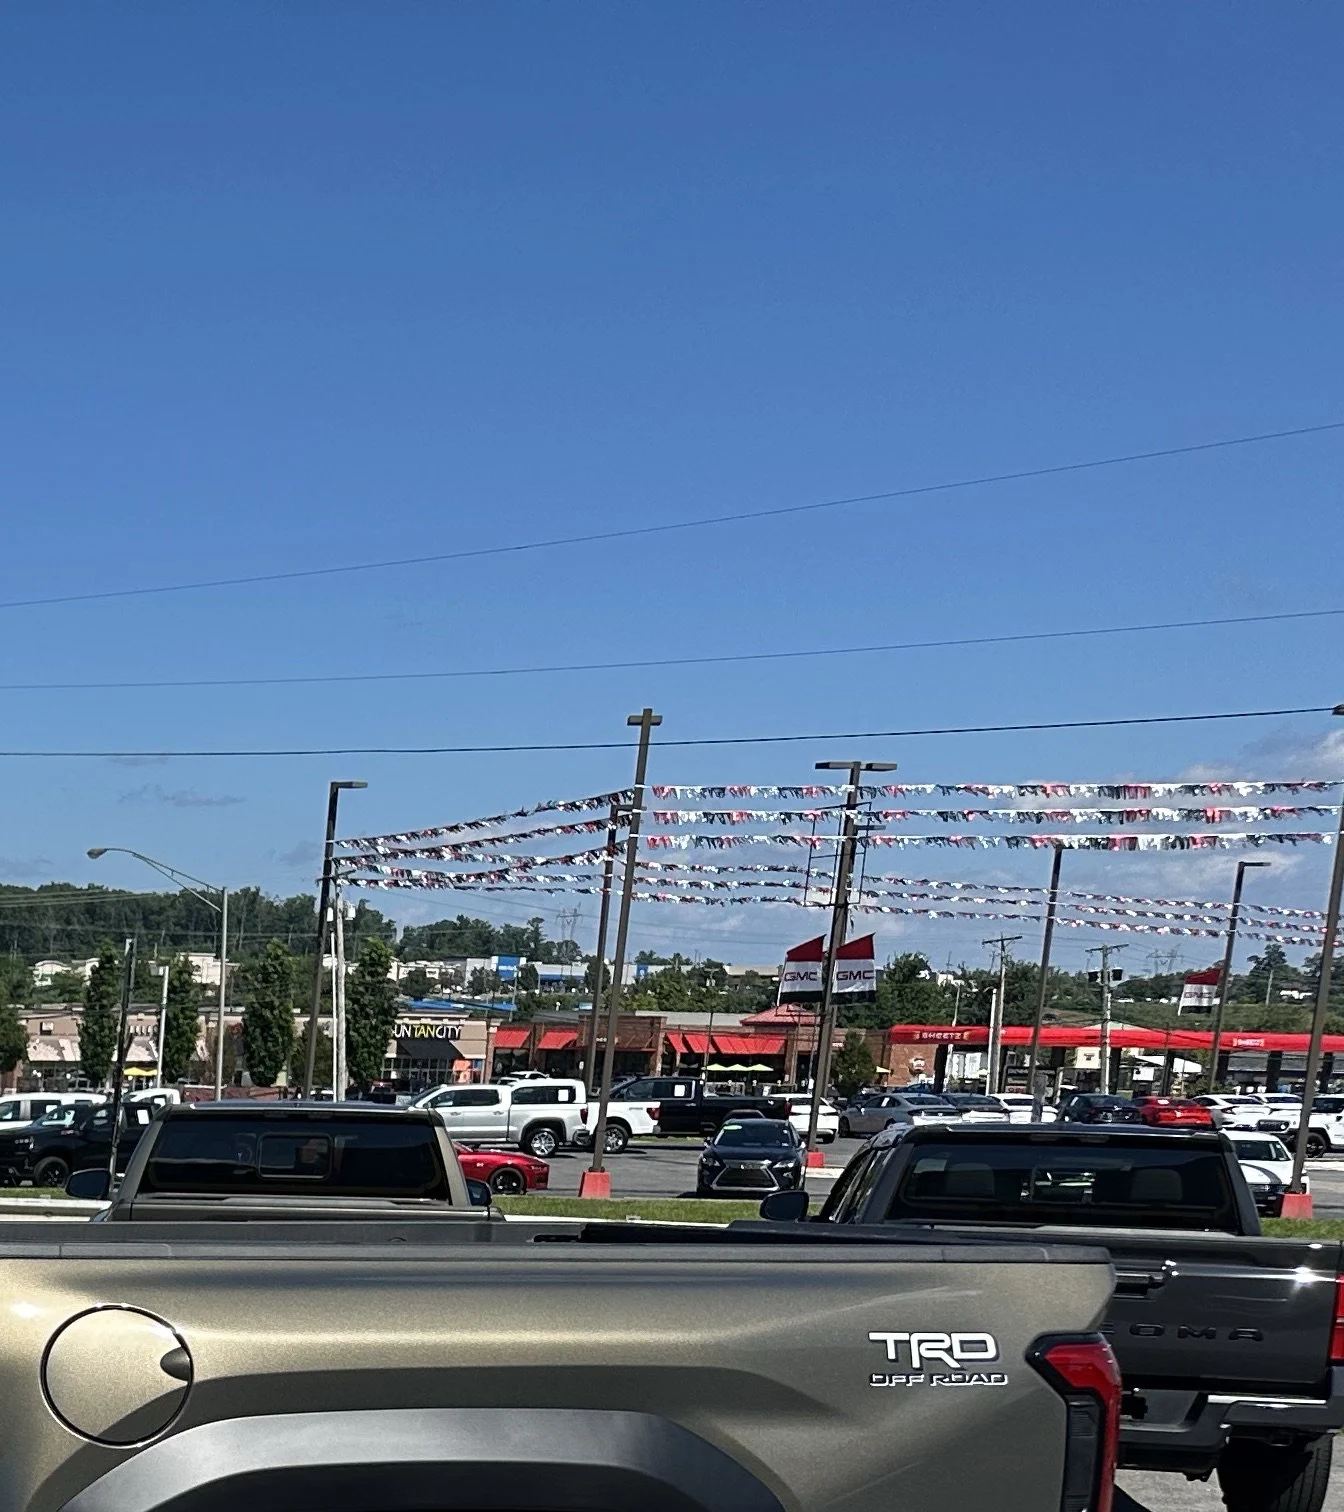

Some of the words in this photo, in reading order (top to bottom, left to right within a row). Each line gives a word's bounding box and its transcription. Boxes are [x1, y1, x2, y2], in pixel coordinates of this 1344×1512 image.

[783, 971, 818, 982] GMC
[836, 969, 875, 981] GMC
[392, 1024, 412, 1038] UN
[868, 1331, 999, 1370] TRD
[868, 1373, 925, 1387] OFF
[932, 1373, 1009, 1387] ROAD
